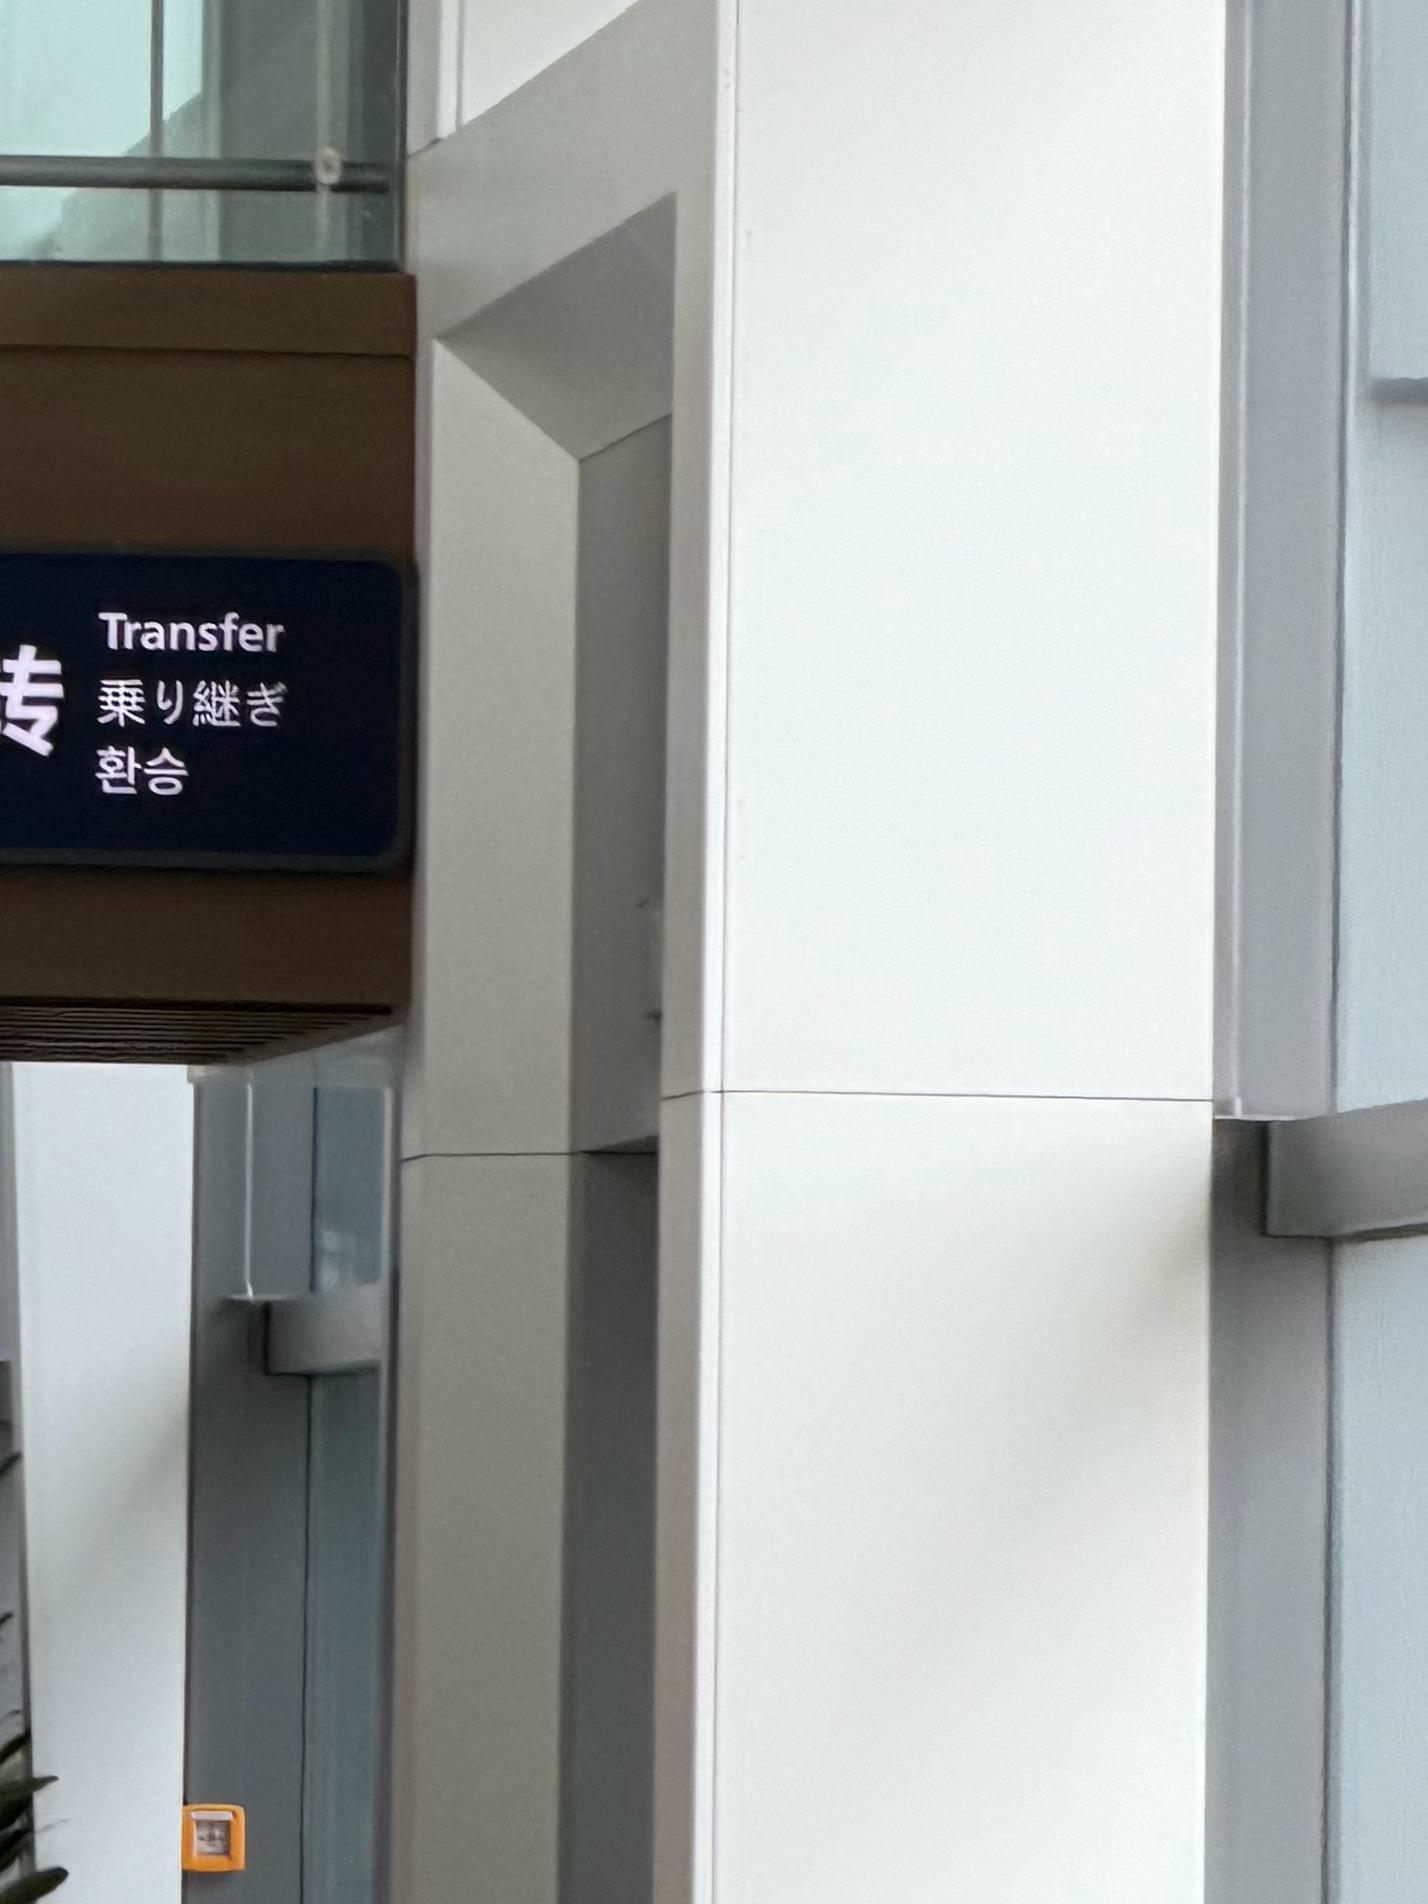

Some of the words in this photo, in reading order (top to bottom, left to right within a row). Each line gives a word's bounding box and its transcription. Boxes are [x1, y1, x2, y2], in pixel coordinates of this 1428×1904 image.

[97, 611, 285, 653] Transfer
[97, 678, 289, 728] 乗り継ぎ
[95, 746, 190, 796] 환승
